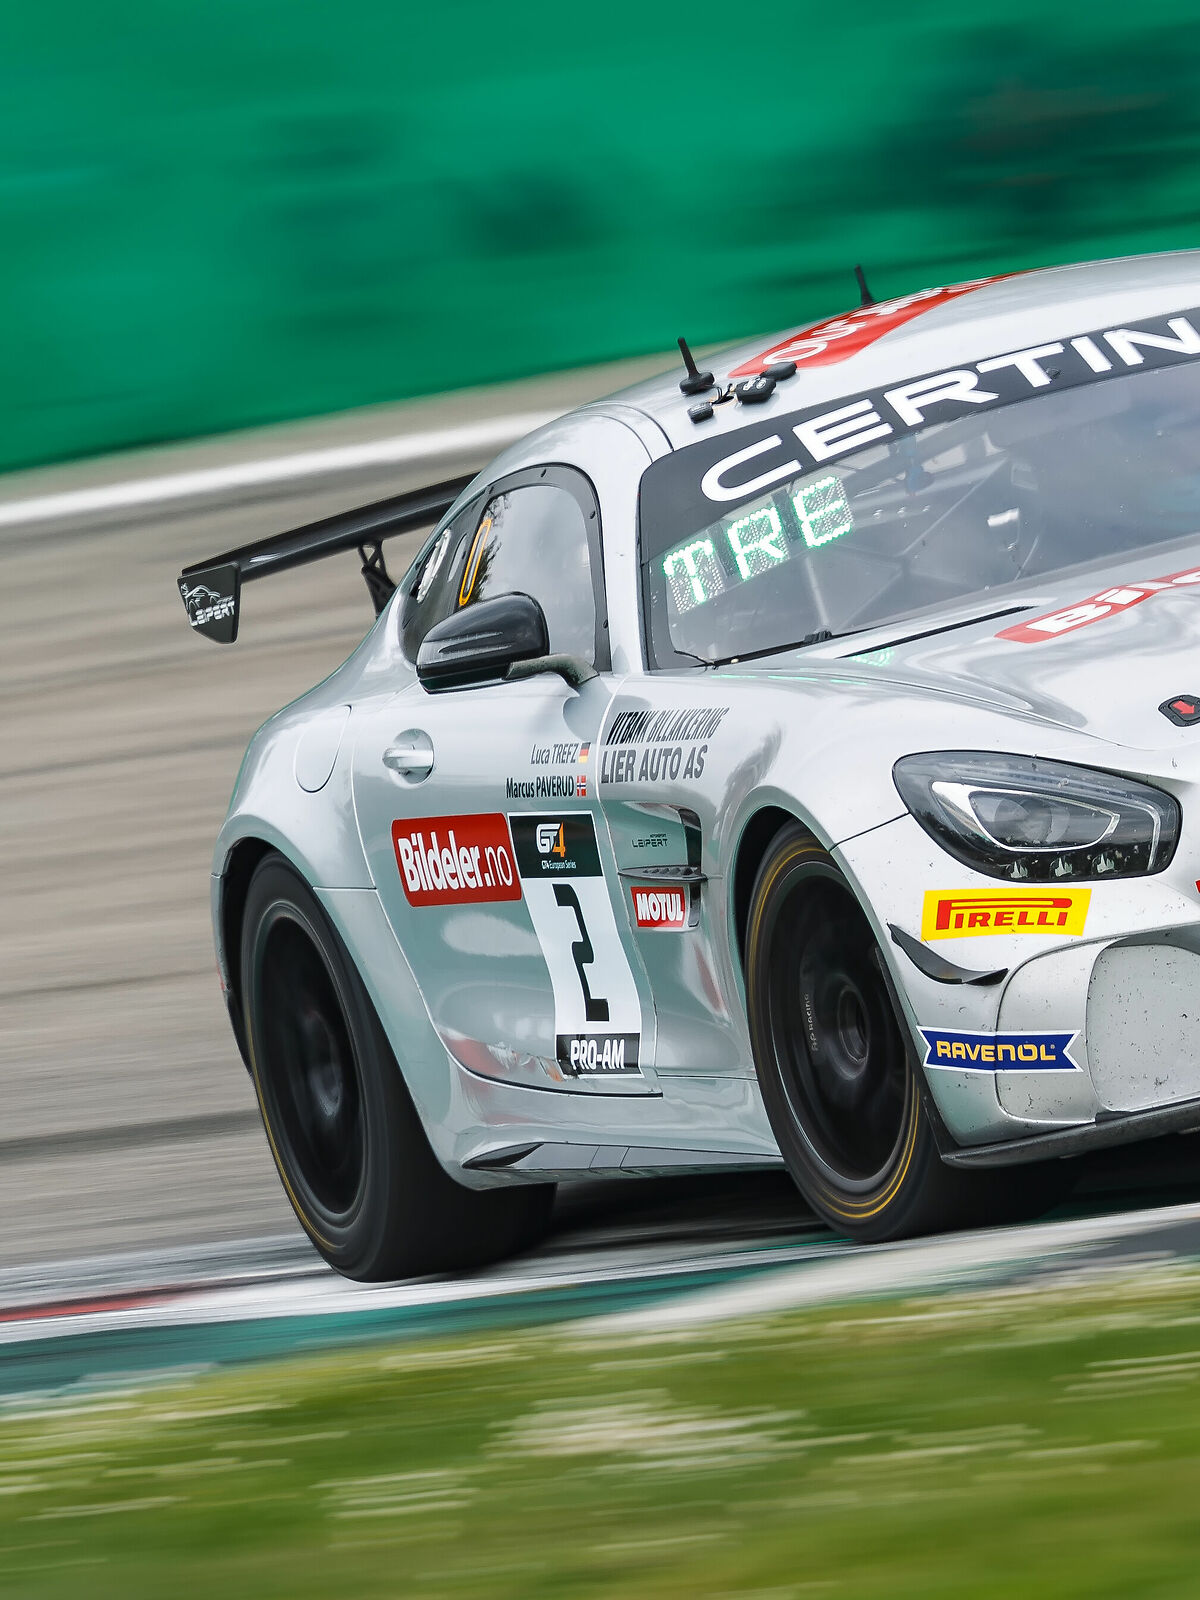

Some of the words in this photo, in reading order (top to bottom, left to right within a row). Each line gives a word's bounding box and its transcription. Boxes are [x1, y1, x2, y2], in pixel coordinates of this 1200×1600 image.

[663, 475, 852, 605] TRE
[645, 707, 730, 743] BILLAKKERING
[531, 743, 551, 765] Luca
[552, 742, 580, 764] TREFZ
[601, 749, 637, 784] LIER
[638, 746, 682, 782] AUTO
[683, 744, 708, 779] AS
[506, 776, 535, 799] Marcus
[536, 775, 575, 798] PAVERUD
[535, 820, 566, 858] GT4
[631, 838, 668, 848] LEIPERT
[397, 830, 514, 893] Bildeler.no
[636, 892, 684, 922] MOTUL
[935, 897, 1073, 931] PIRELLI
[552, 884, 610, 1022] 2
[570, 1038, 625, 1071] PRO-AM
[936, 1040, 1057, 1062] RAVENOL
